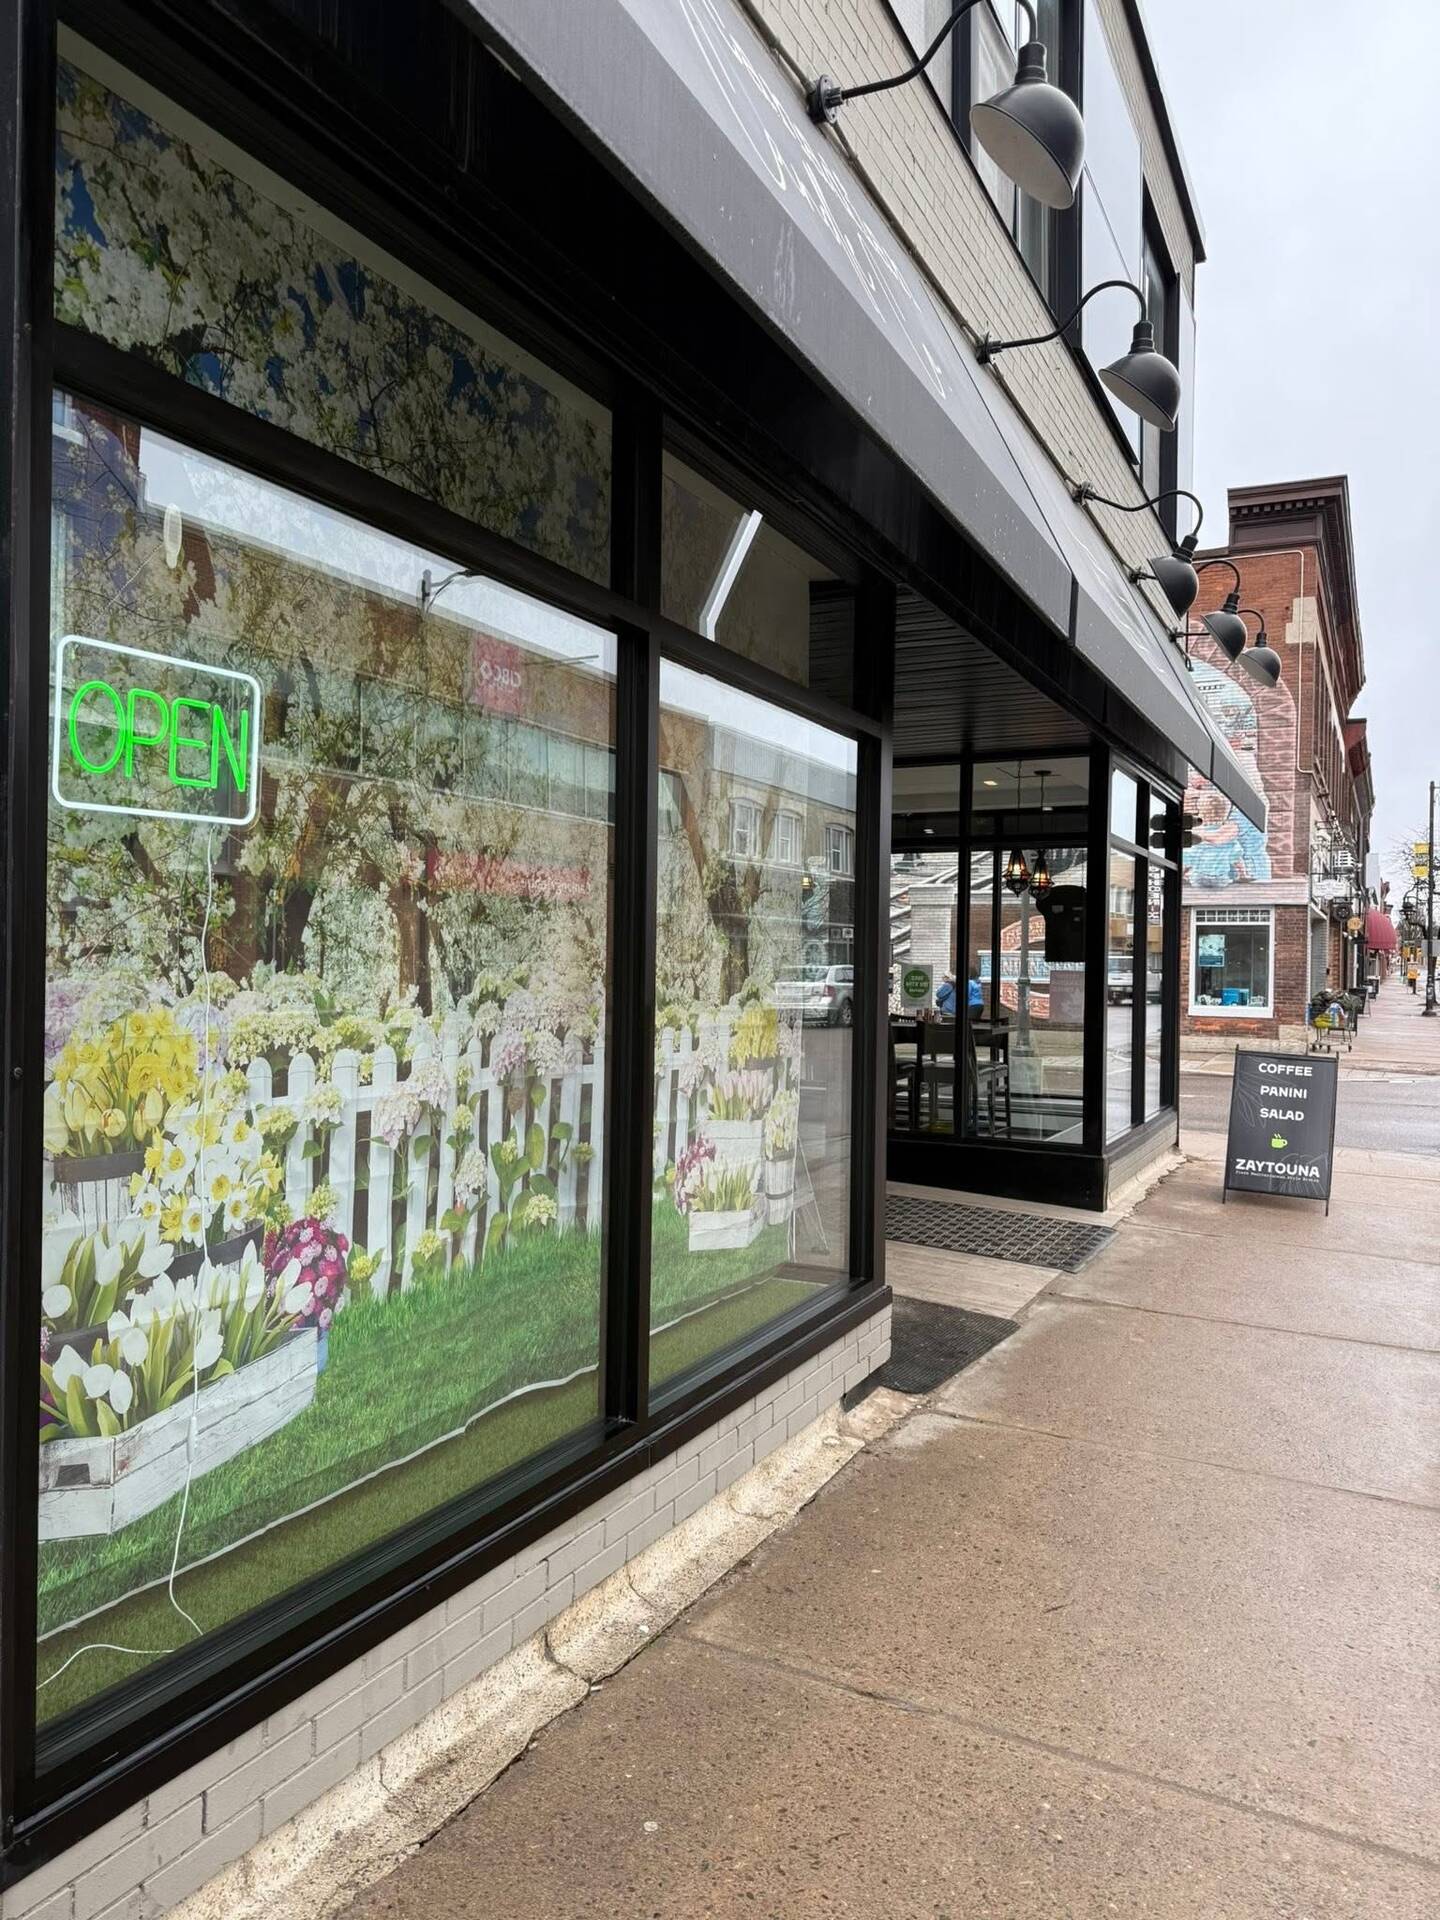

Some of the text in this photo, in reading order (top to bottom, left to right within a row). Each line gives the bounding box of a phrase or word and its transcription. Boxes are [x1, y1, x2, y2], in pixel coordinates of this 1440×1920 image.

[69, 680, 249, 793] OPEN
[1258, 1063, 1313, 1077] COFFEE
[1260, 1085, 1308, 1099] PANINI
[1260, 1107, 1305, 1121] SALAD
[1235, 1158, 1320, 1178] ZAYTOUNA
